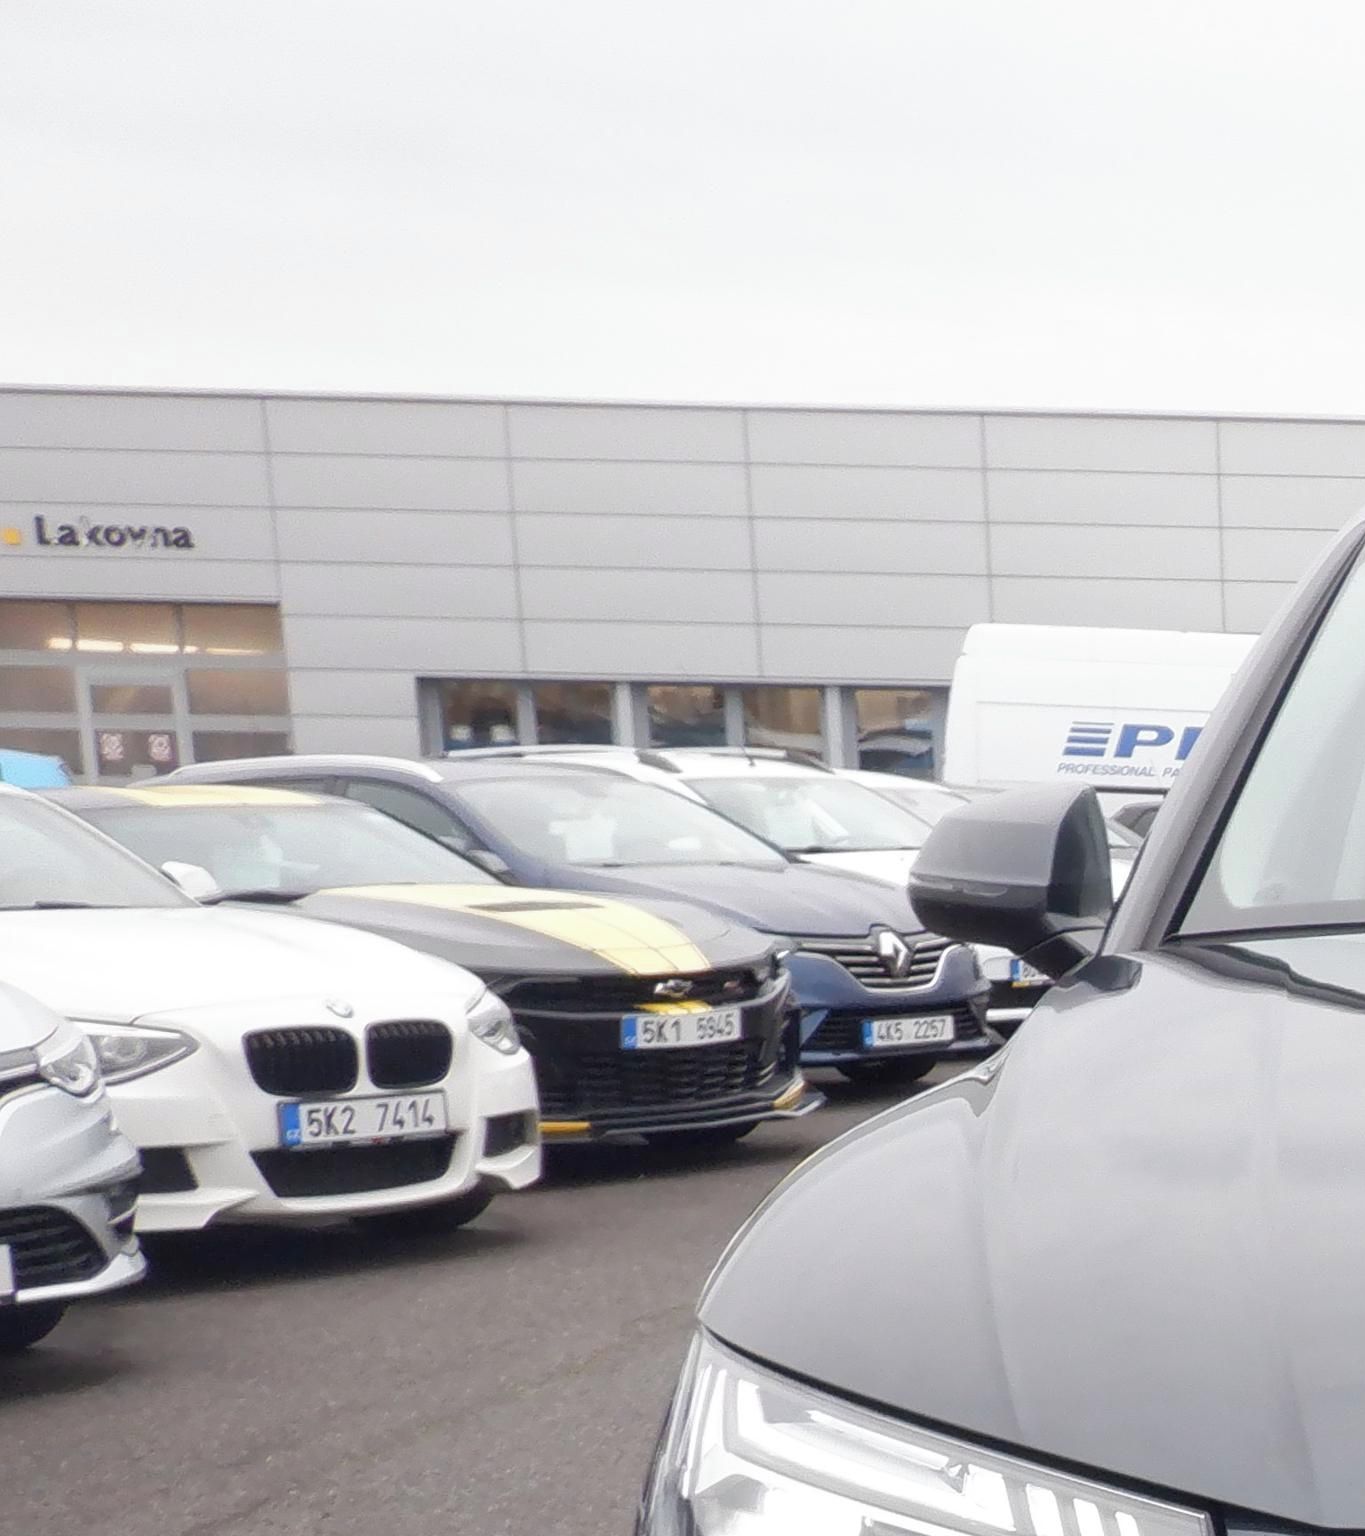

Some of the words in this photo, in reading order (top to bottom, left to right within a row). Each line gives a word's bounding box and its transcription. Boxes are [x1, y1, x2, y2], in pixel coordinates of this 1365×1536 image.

[1057, 762, 1154, 777] PROFESSIONAL
[642, 1019, 682, 1043] 5K1
[307, 1105, 356, 1137] 5K2
[376, 1099, 435, 1132] 7414
